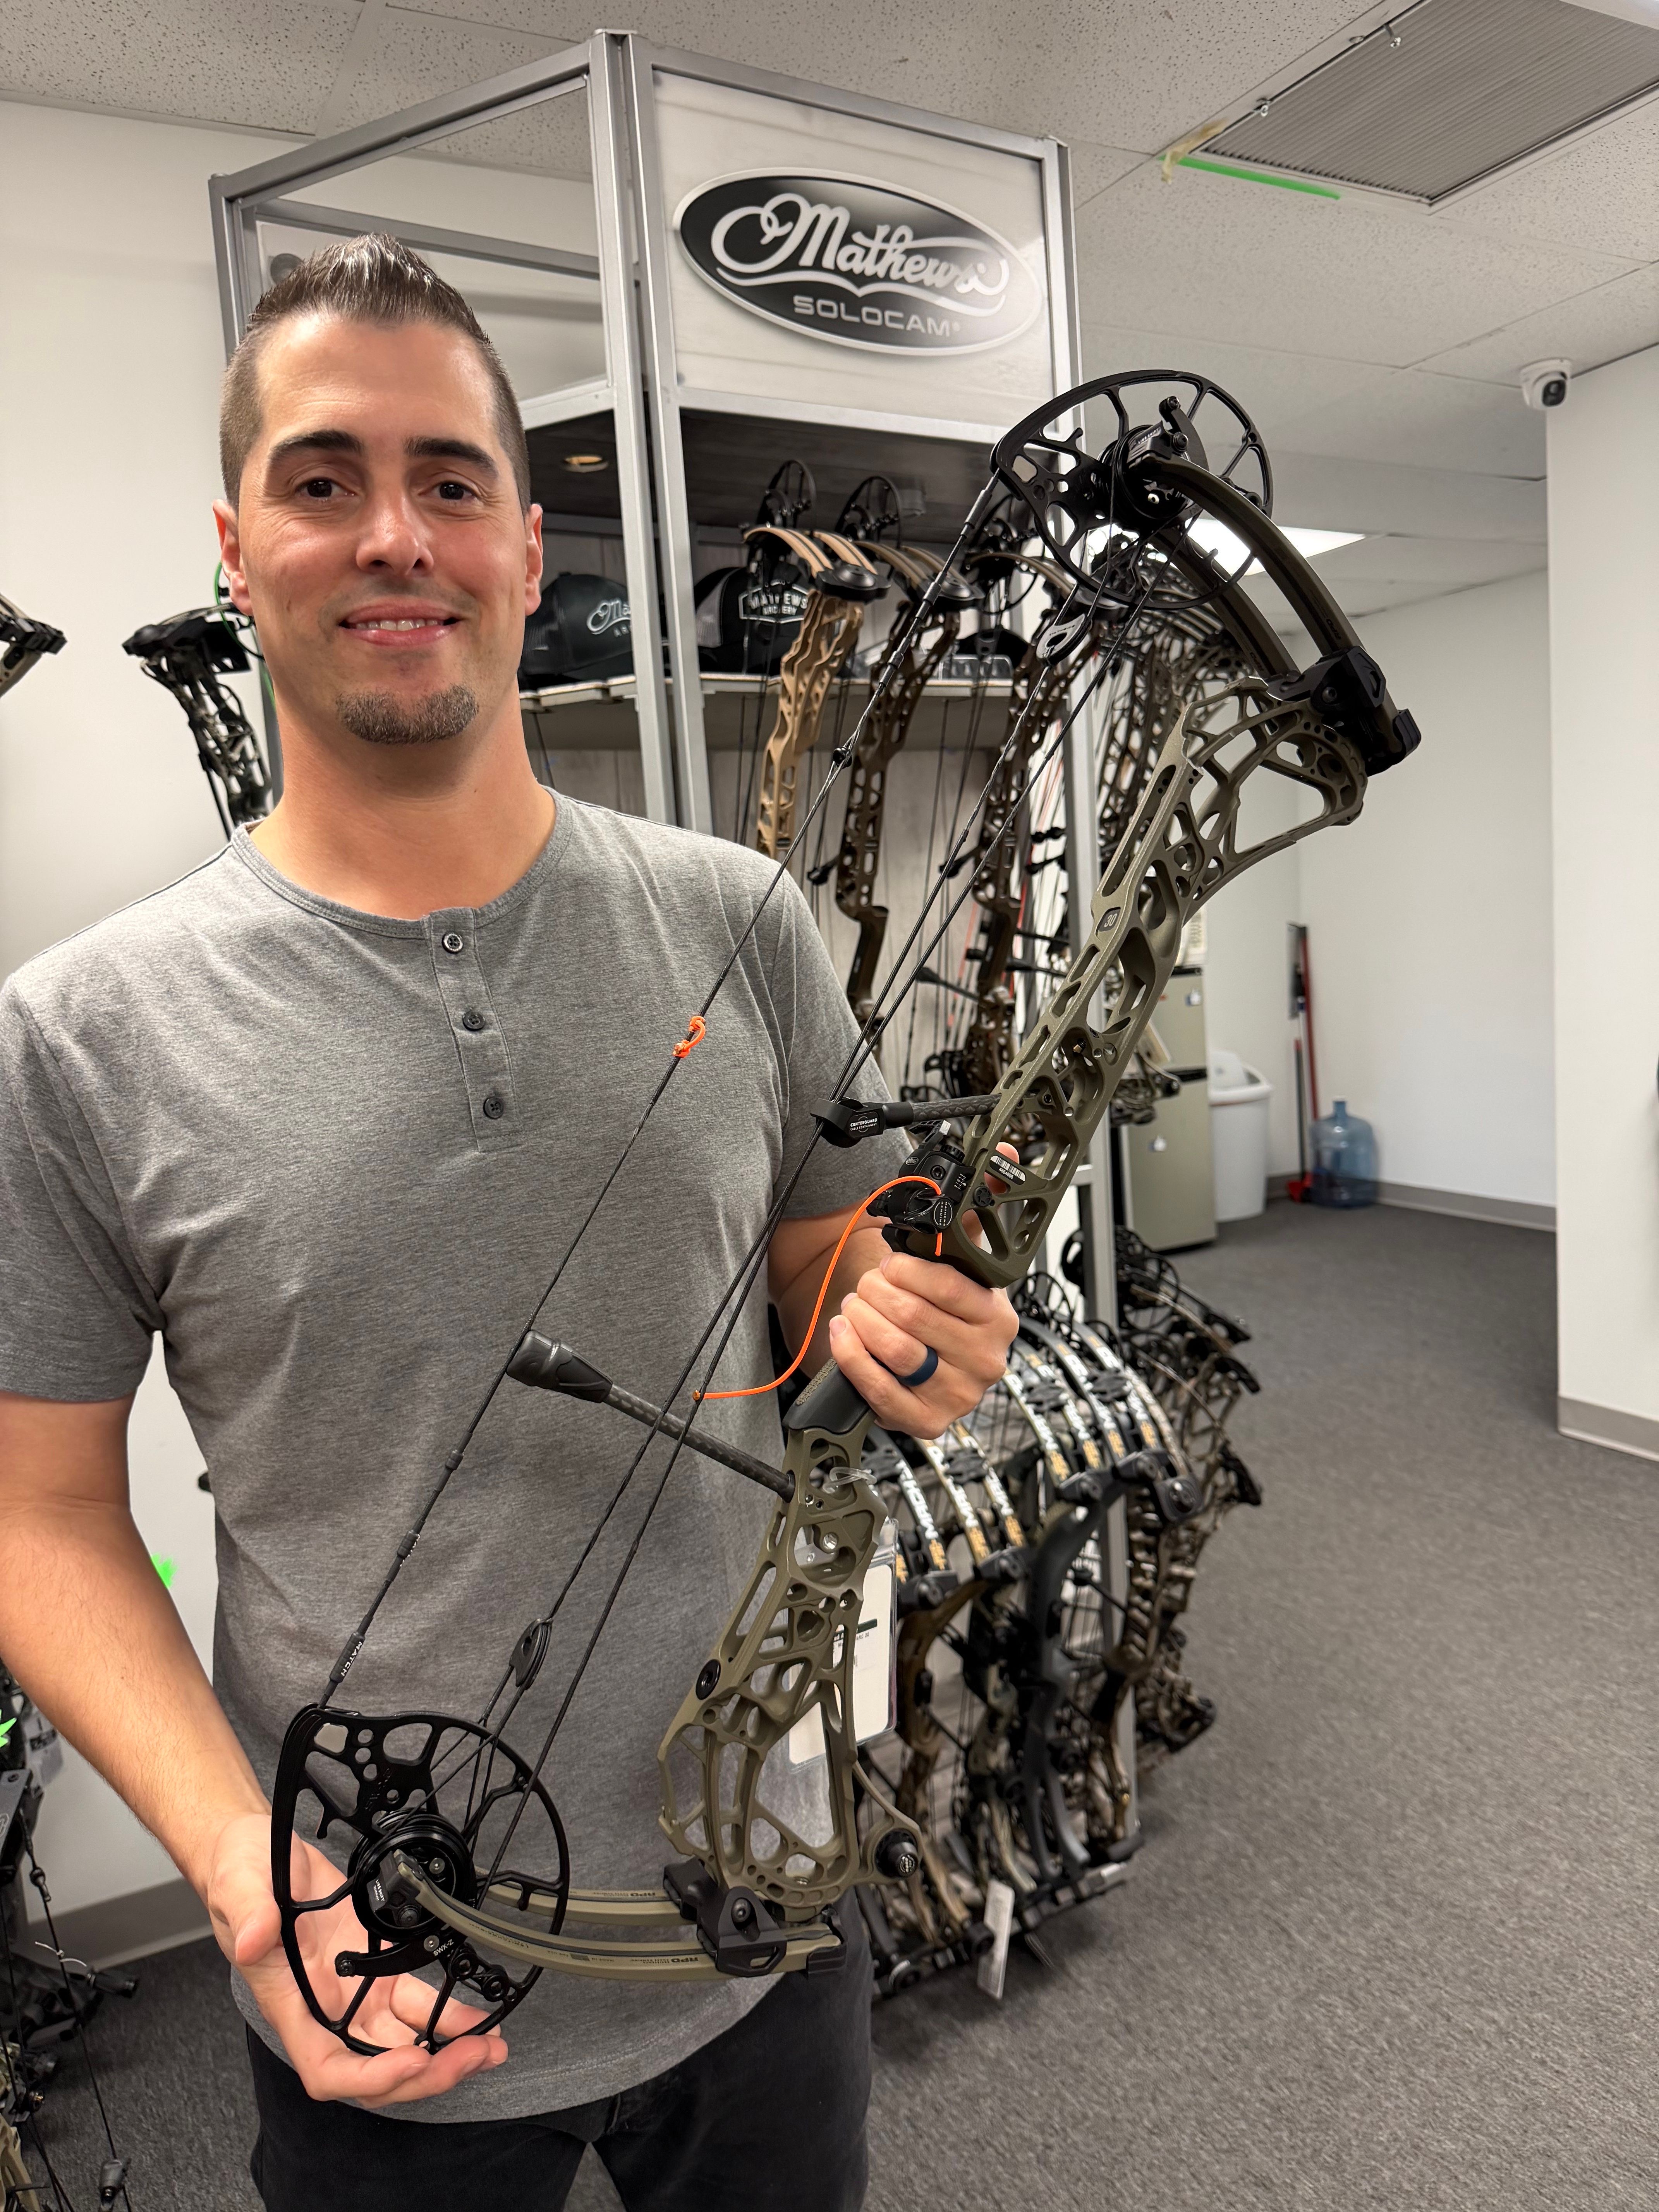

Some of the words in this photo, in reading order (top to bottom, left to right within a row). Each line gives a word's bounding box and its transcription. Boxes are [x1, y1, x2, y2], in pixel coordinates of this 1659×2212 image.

[711, 193, 1009, 295] Mathews
[1104, 913, 1118, 927] 30
[850, 1118, 878, 1127] CENTERGUARD
[341, 1641, 363, 1677] MATCH
